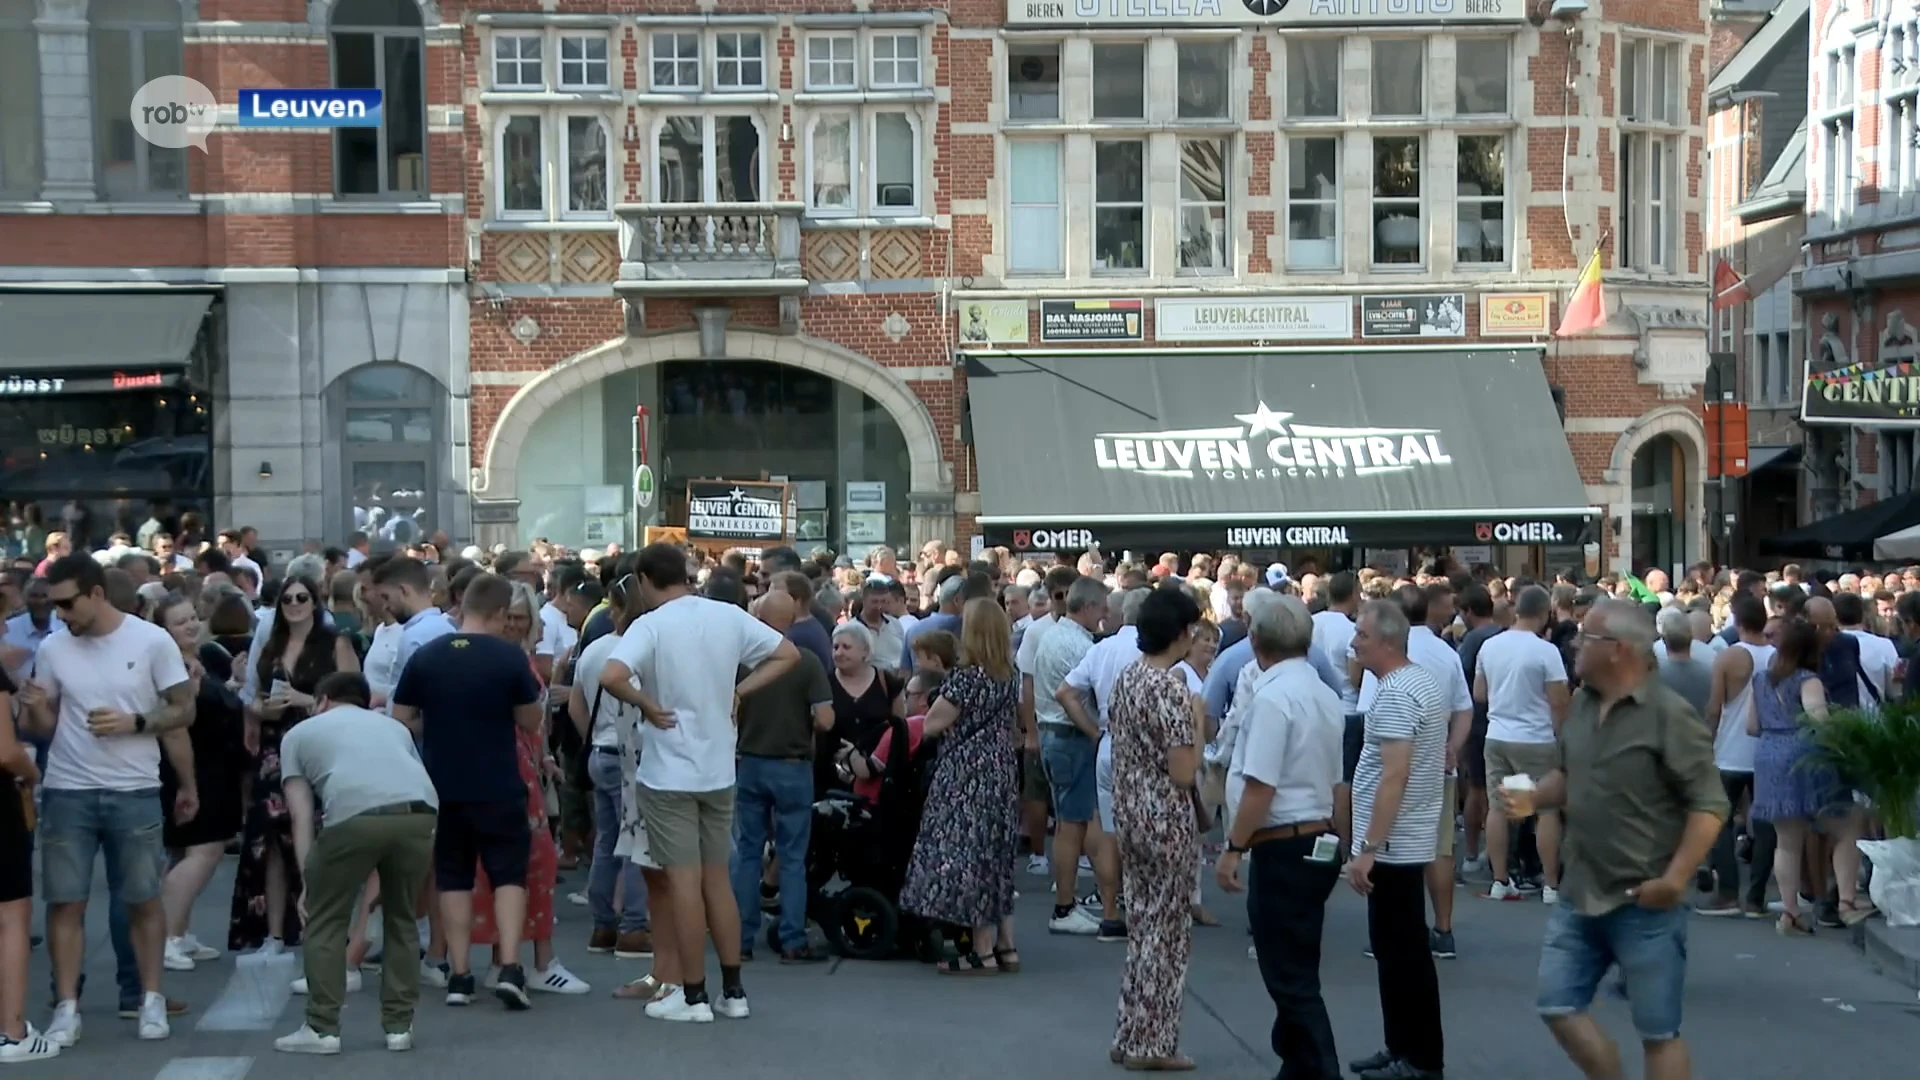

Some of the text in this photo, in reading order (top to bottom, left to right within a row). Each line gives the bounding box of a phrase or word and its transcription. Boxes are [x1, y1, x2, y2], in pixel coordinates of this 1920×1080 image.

[1026, 3, 1064, 18] BIEREN
[1046, 312, 1124, 323] BAL NASJONAL
[1194, 305, 1309, 324] LEUVEN CENTRAL
[37, 424, 124, 445] WÜRST
[1094, 435, 1452, 469] LEUVEN CENTRAL
[690, 500, 783, 517] LEUVEN CENTRAL
[695, 518, 776, 531] BONNEKESKOT
[1494, 522, 1563, 542] OMER.
[1227, 526, 1349, 546] LEUVEN CENTRAL
